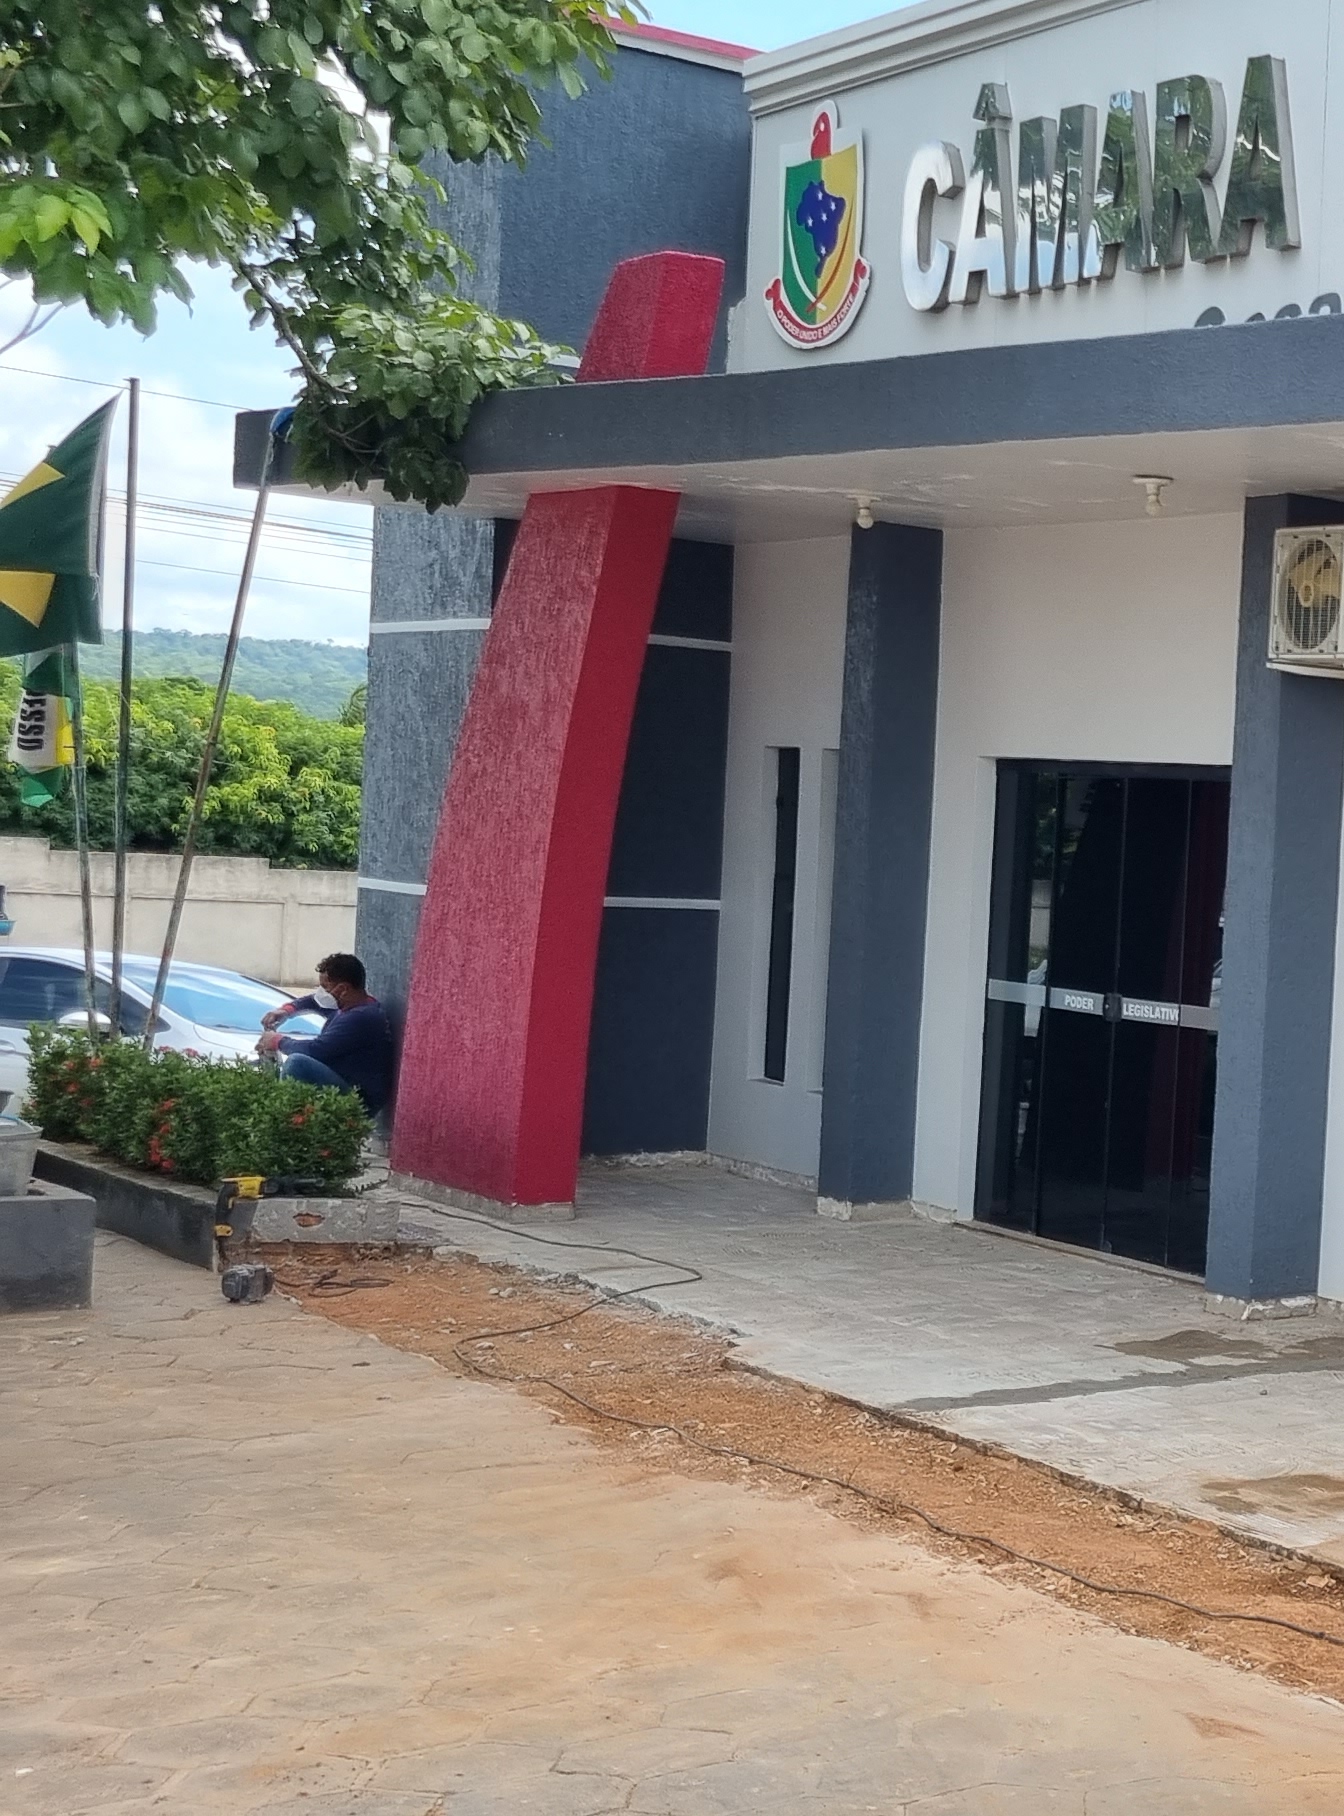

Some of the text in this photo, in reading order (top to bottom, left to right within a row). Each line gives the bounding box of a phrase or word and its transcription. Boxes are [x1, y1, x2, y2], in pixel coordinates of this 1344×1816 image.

[901, 53, 1302, 312] CÂMARA
[781, 315, 800, 337] PODER
[1064, 994, 1094, 1011] PODER
